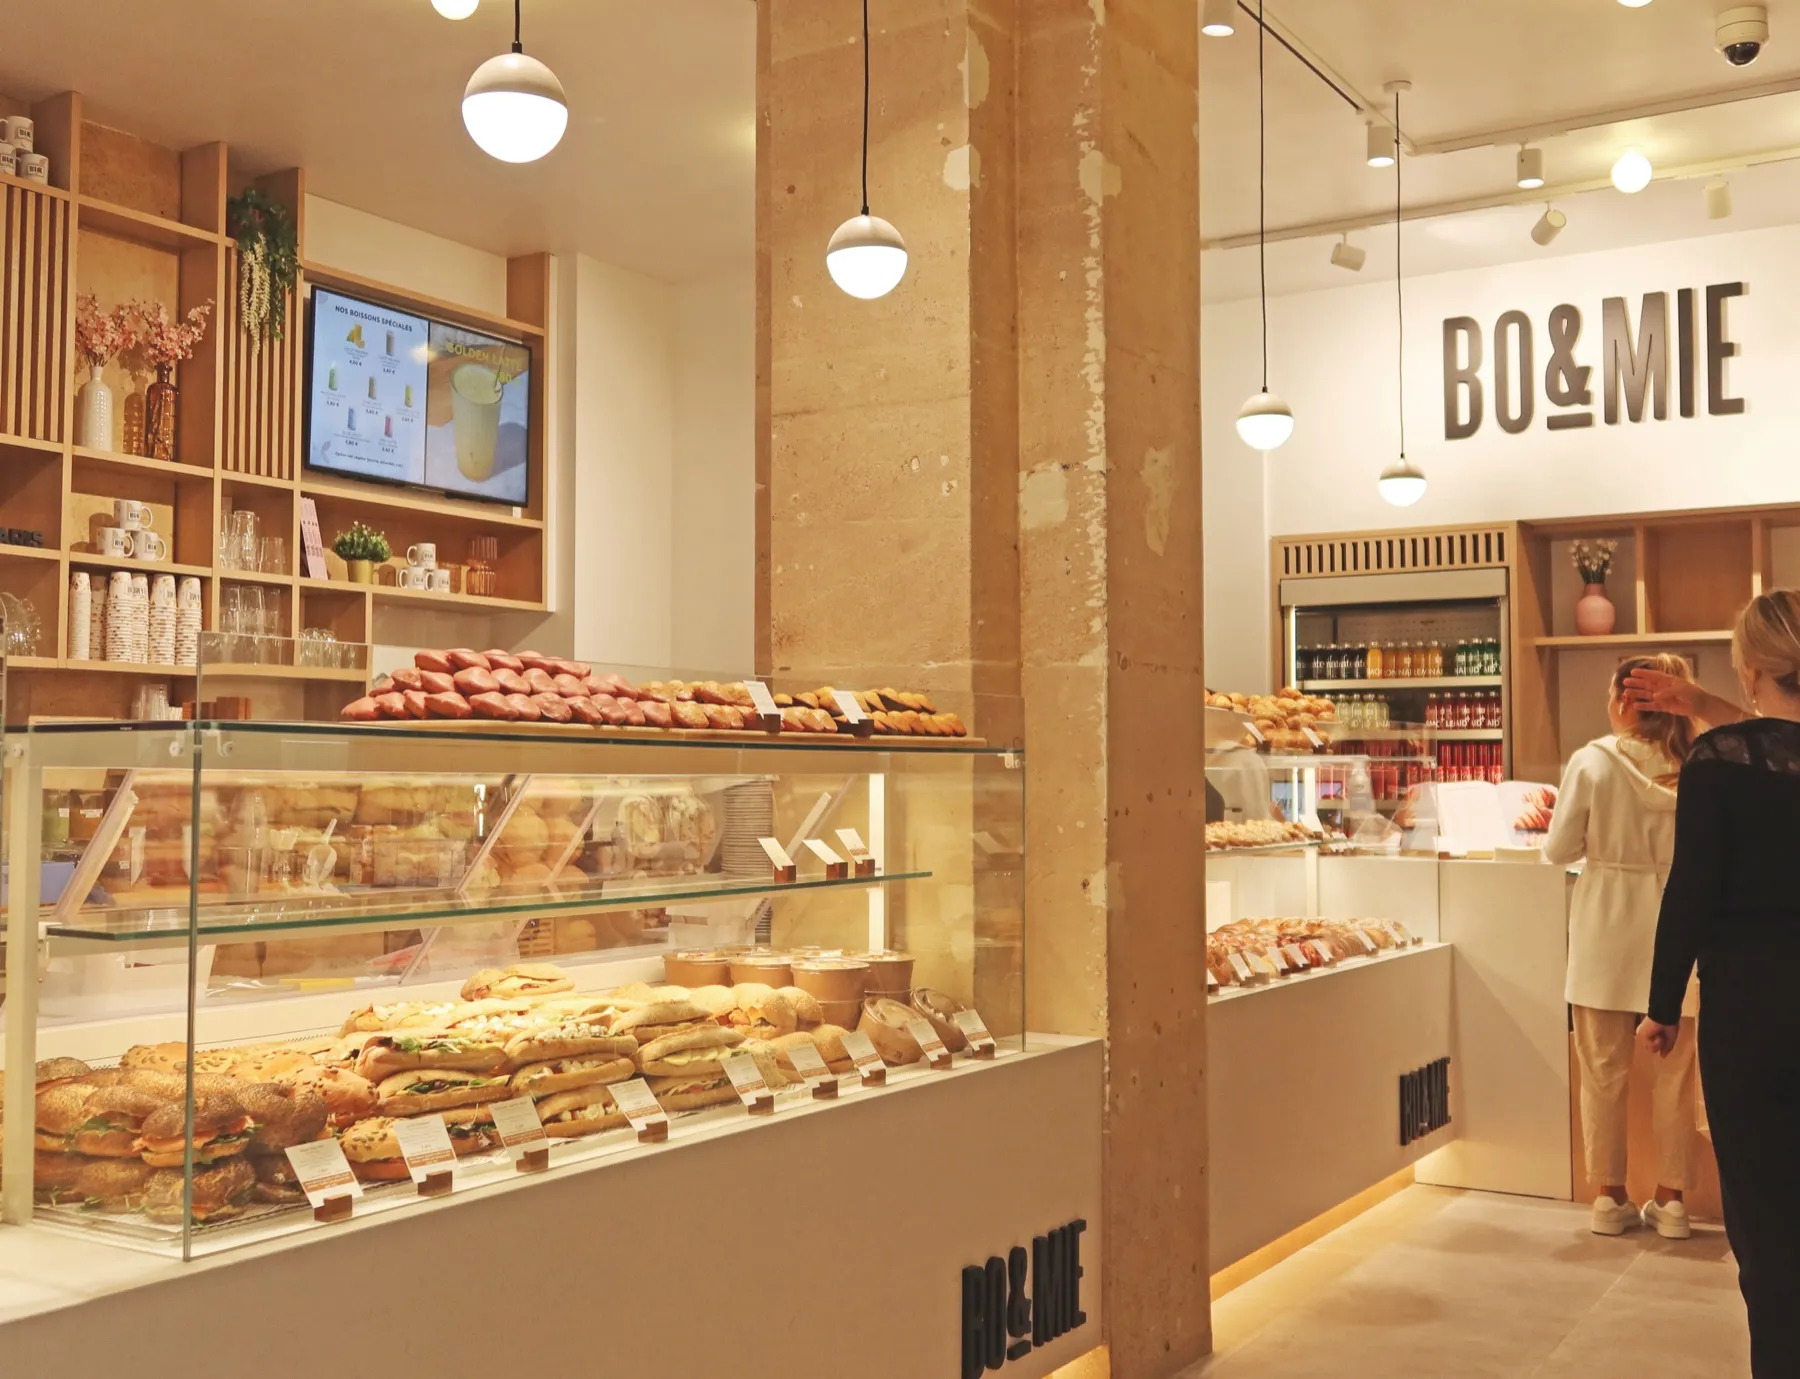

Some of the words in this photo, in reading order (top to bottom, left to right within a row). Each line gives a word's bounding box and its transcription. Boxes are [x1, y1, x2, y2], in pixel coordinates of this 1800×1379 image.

[335, 305, 349, 315] NOS
[349, 309, 381, 324] BOISSONS
[381, 318, 413, 332] SPÉCIALES
[446, 341, 489, 362] GOLDEN
[1443, 281, 1746, 441] BO&MIE
[961, 1218, 1087, 1379] BO&MIE
